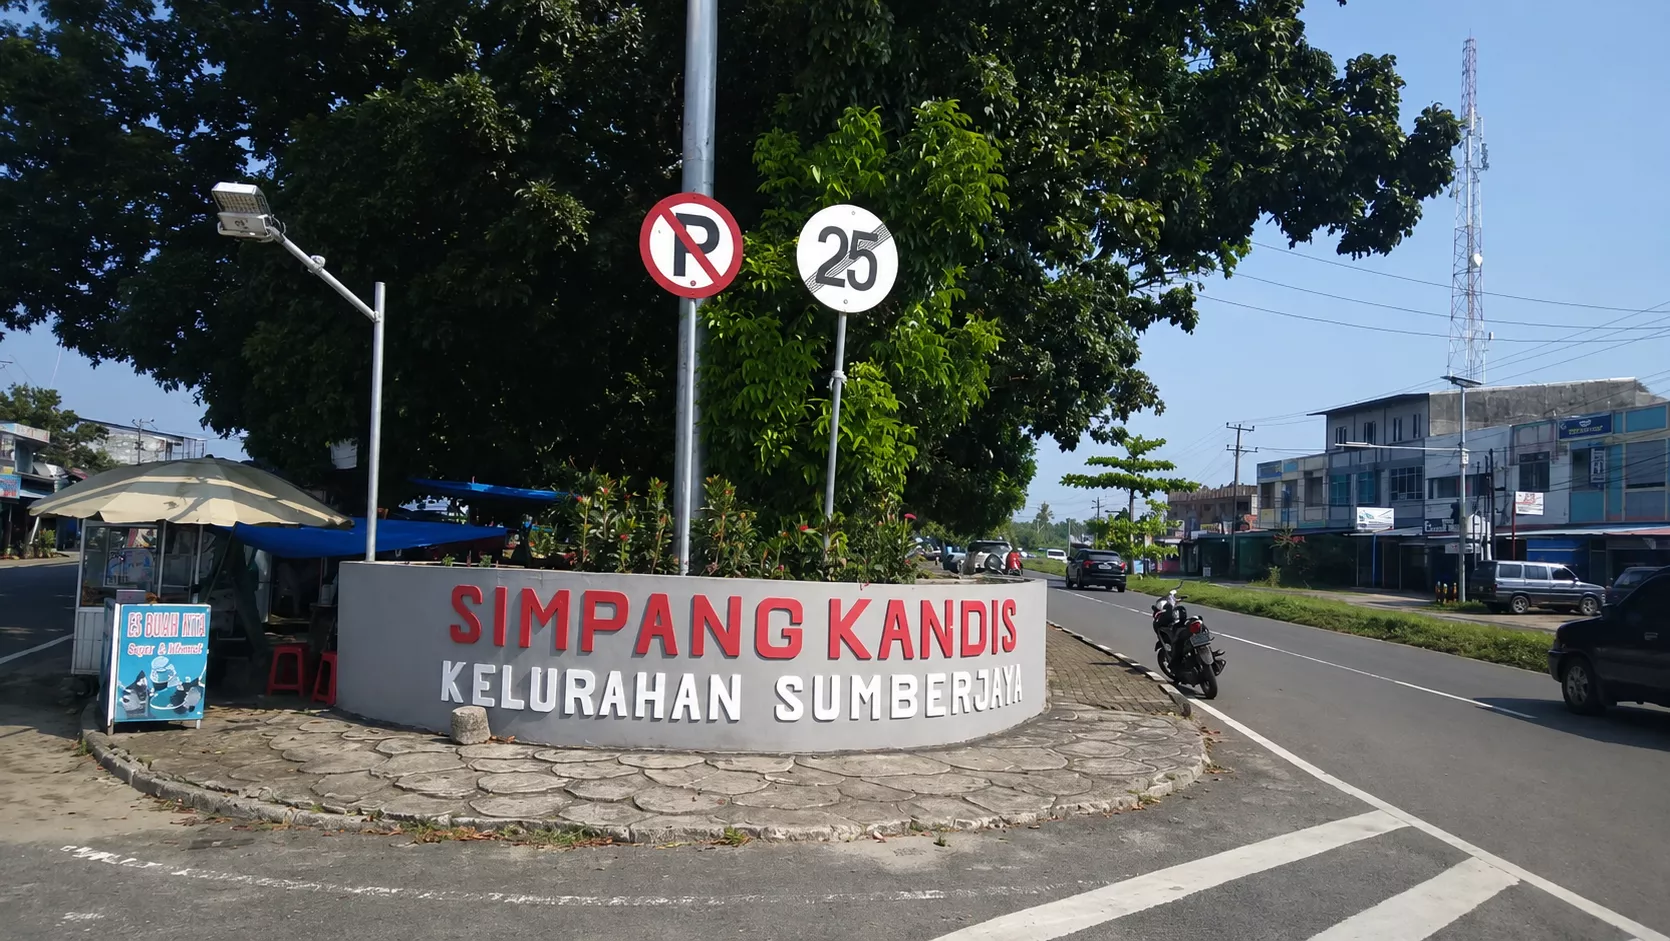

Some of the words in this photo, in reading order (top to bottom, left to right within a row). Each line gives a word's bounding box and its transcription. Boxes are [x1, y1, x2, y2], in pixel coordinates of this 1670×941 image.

[673, 212, 720, 277] P
[815, 225, 878, 291] 25
[145, 612, 179, 637] BUAH
[449, 584, 803, 660] SIMPANG
[827, 598, 1017, 660] KANDIS
[441, 660, 742, 721] KELURAHAN
[774, 664, 1023, 723] SUMBERJAYA
